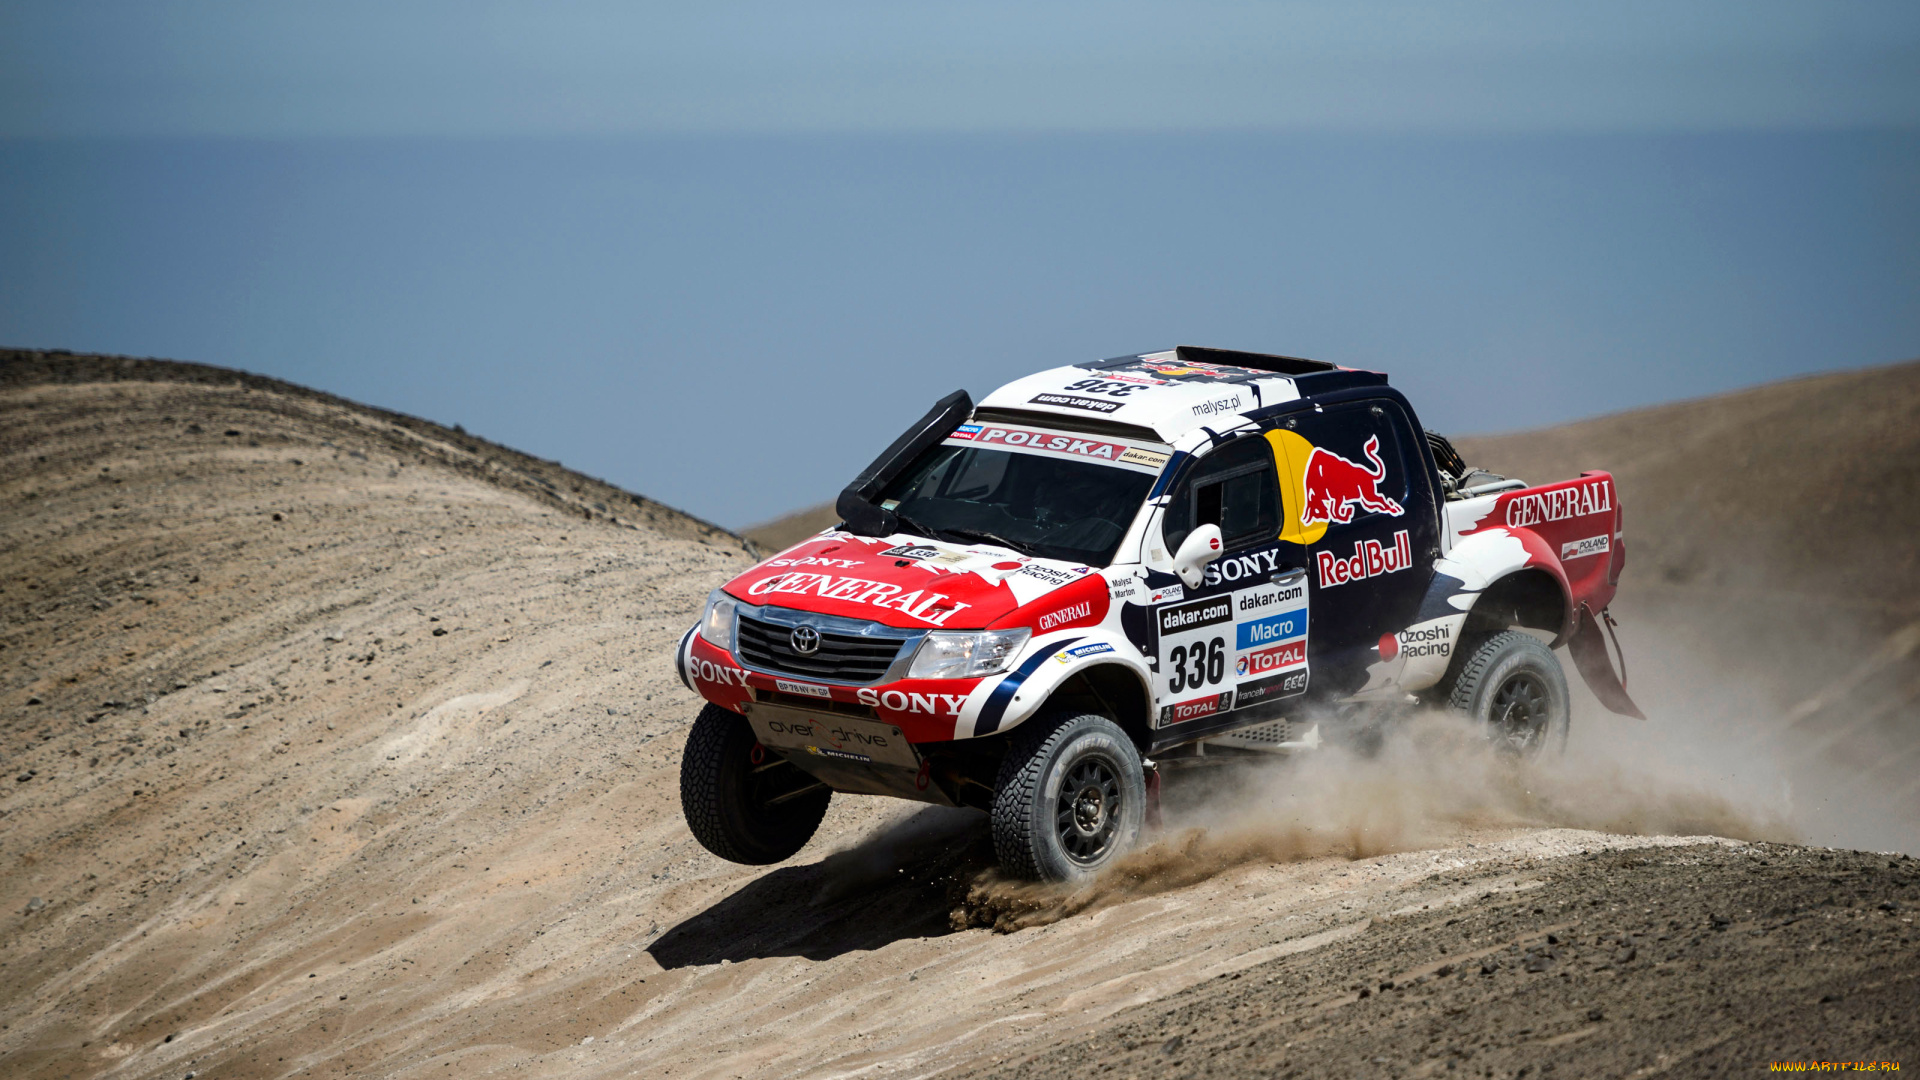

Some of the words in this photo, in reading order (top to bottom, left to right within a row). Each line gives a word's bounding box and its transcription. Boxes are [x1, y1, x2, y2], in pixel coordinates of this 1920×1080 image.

[1064, 379, 1150, 397] 336
[1037, 394, 1118, 412] dakar.com
[1192, 394, 1242, 416] malysz.pl
[982, 429, 1114, 459] POLSKA
[1123, 451, 1166, 464] dakar.com
[1506, 480, 1612, 528] GENERALI
[1579, 536, 1609, 550] POLAND
[767, 556, 865, 569] SONY
[1203, 548, 1279, 586] SONY
[1317, 541, 1365, 589] Red
[1364, 529, 1412, 579] Bull
[1024, 564, 1077, 580] Ozoshi
[1112, 577, 1132, 588] Malysz
[1162, 586, 1182, 595] POLAND
[748, 571, 972, 627] GENERALI
[1115, 588, 1136, 599] Marton
[1240, 586, 1302, 611] dakar.com
[1039, 602, 1091, 630] GENERALI
[1163, 604, 1229, 629] dakar.com
[1250, 620, 1294, 643] Macro
[1399, 624, 1449, 643] Ozoshi
[1074, 642, 1112, 655] MICHELIN
[1400, 641, 1450, 659] Racing
[1169, 636, 1226, 694] 336
[1252, 646, 1304, 671] TOTAL
[689, 656, 751, 688] SONY
[856, 688, 970, 716] SONY
[1175, 701, 1217, 718] TOTAL
[769, 719, 814, 738] over
[827, 751, 870, 763] MICHELIN
